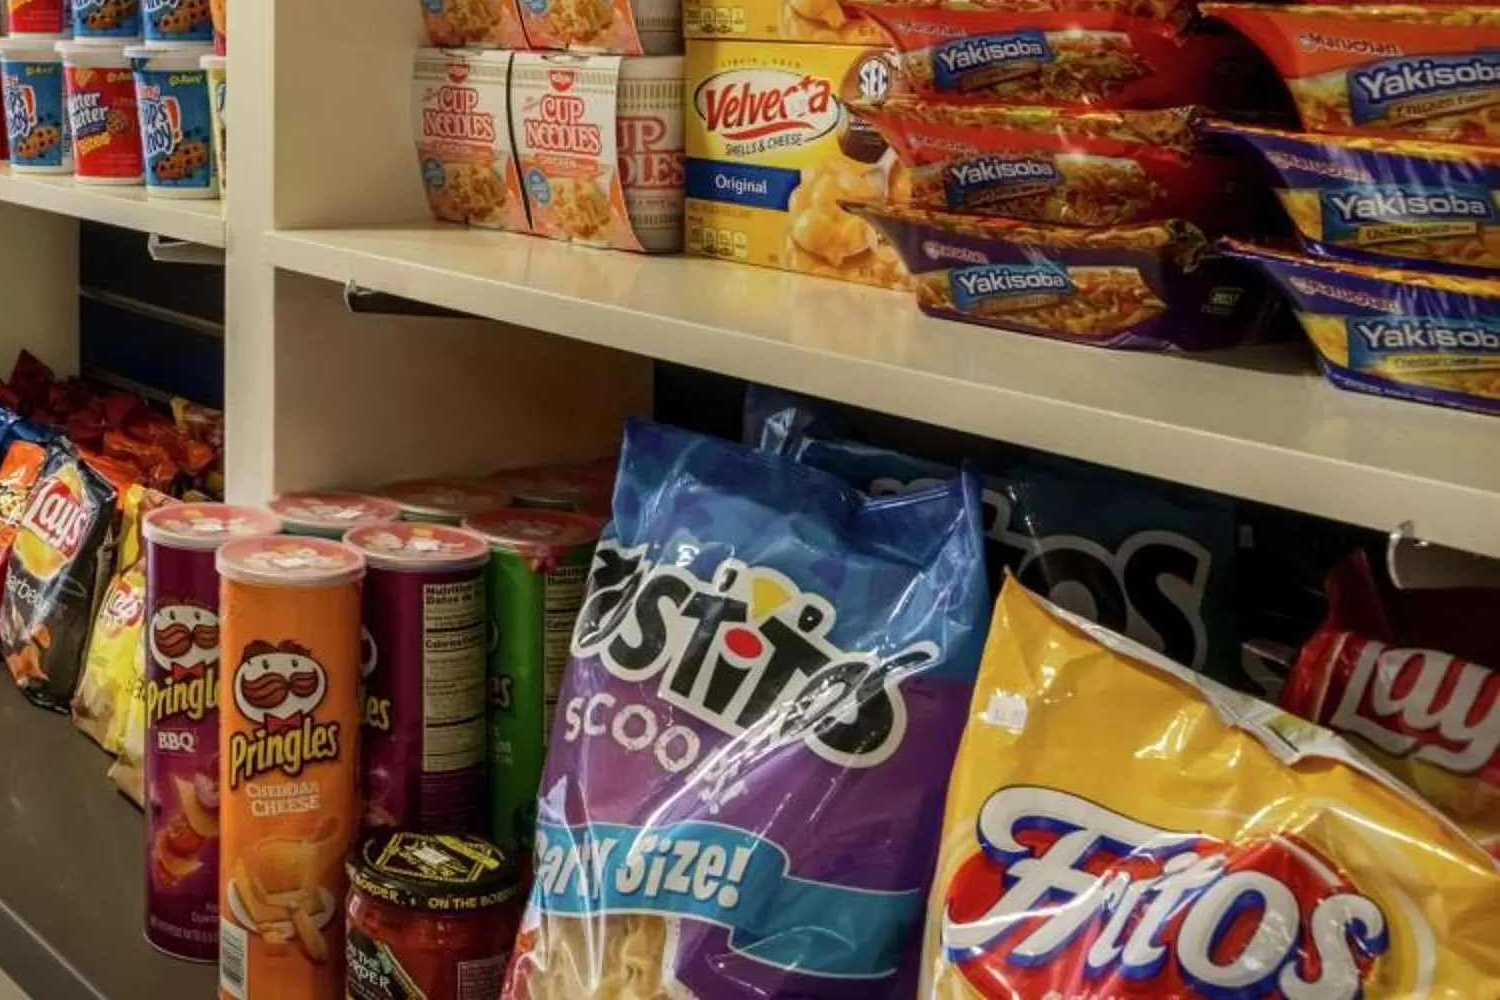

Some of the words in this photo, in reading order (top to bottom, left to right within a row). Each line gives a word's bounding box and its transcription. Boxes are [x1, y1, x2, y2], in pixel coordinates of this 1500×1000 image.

[940, 39, 1043, 74] Yakisoba
[438, 86, 479, 112] CUP
[540, 95, 585, 124] CUP
[424, 109, 495, 143] NOODLES
[524, 119, 602, 153] NOODLES
[766, 133, 803, 151] CHEESE
[714, 173, 768, 195] Original
[951, 160, 1054, 187] Yakisoba
[1332, 192, 1486, 221] Yakisoba
[959, 270, 1066, 298] Yakisoba
[1358, 322, 1500, 349] Yakisob
[146, 668, 220, 729] Pringl
[157, 730, 197, 752] BBQ
[229, 718, 341, 791] Pringles
[244, 780, 321, 799] CHEDDAR
[251, 796, 322, 818] CHEESE
[615, 834, 754, 909] Size!
[428, 896, 449, 910] ON
[452, 897, 477, 909] THE
[940, 783, 1390, 1000] Fritos
[358, 948, 381, 972] THE
